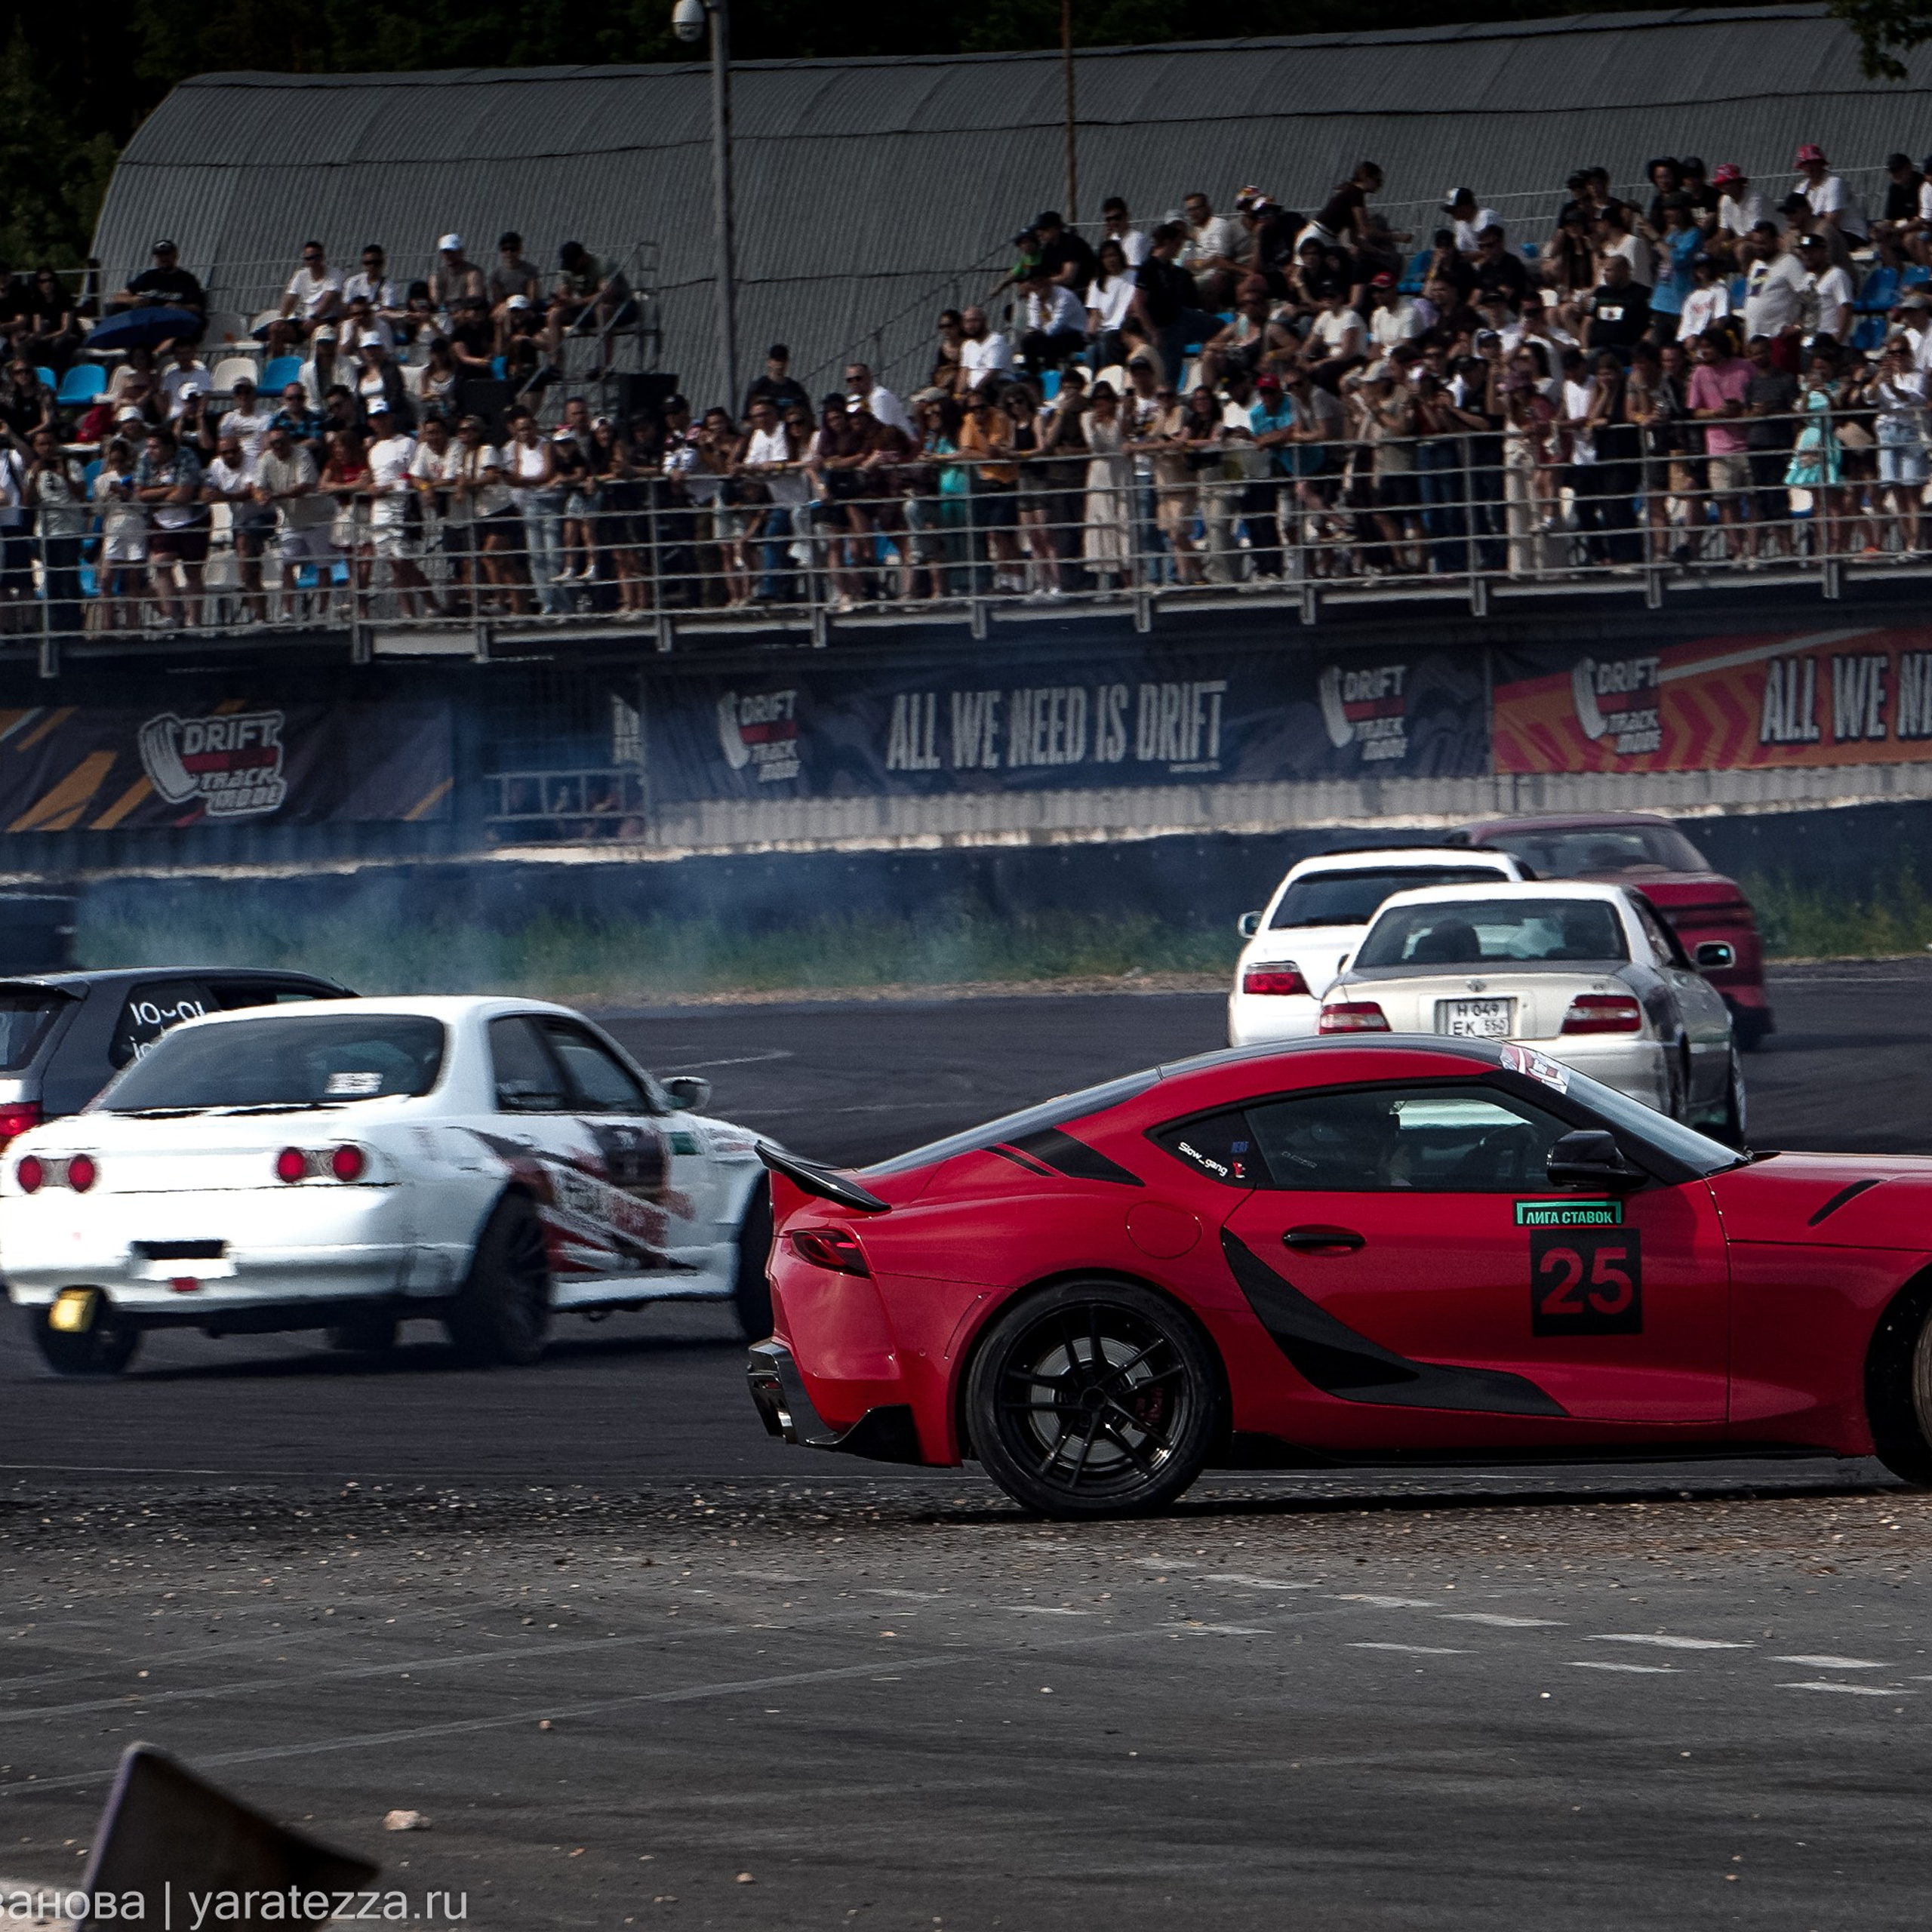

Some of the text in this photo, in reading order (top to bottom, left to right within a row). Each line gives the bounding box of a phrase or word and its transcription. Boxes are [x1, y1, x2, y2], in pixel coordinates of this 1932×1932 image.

[1344, 666, 1406, 702] DRIFT
[1598, 657, 1660, 694] DRIFT
[740, 690, 798, 724] DRIFT
[1760, 658, 1820, 742] ALL
[1833, 656, 1887, 738] WE
[183, 719, 277, 754] DRIFT
[886, 681, 1228, 770] ALL WE NEED IS DRIFT
[1178, 1141, 1229, 1177] Slow_gang
[1526, 1211, 1613, 1224] ЛИГА СТАВОК
[1540, 1247, 1633, 1315] 25
